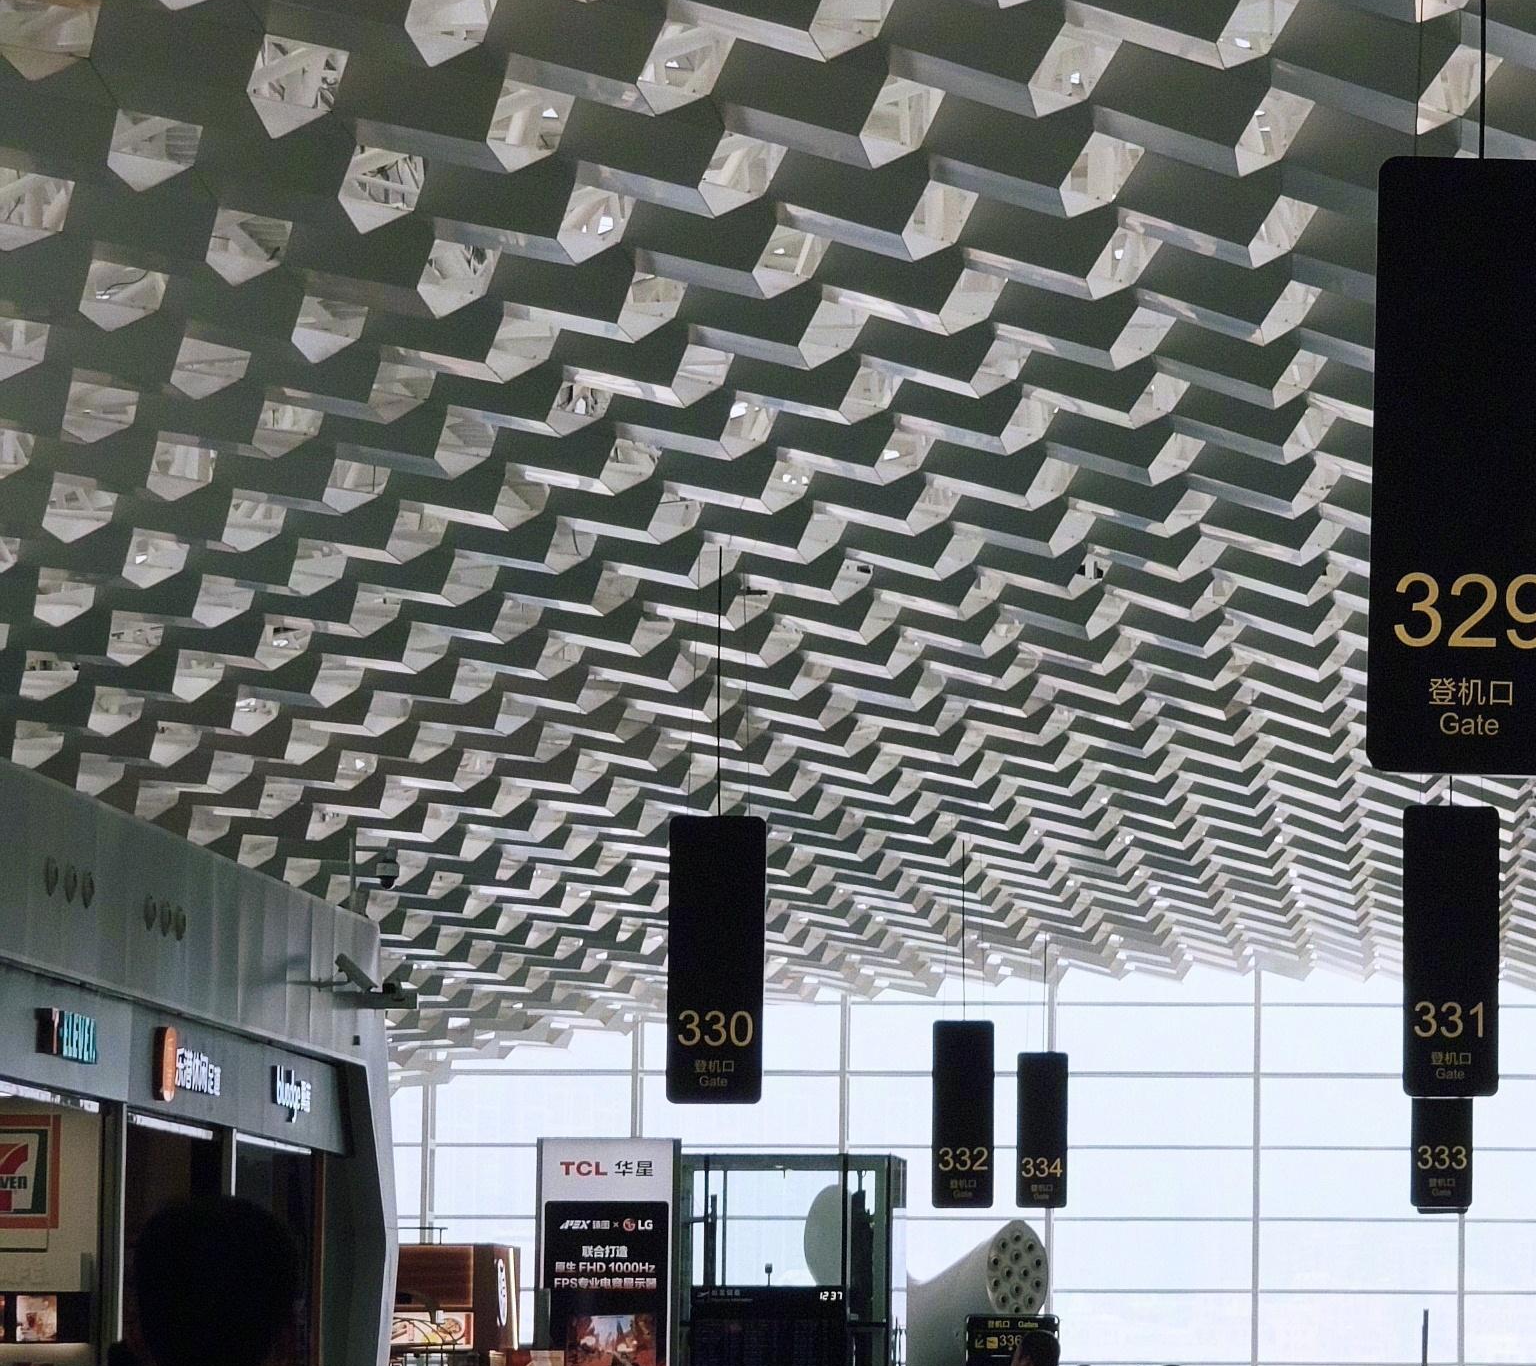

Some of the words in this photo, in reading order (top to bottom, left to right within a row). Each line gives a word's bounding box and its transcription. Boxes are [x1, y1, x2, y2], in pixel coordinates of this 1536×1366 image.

[1429, 677, 1513, 706] 登机口
[1439, 712, 1499, 735] Gate
[1414, 1001, 1484, 1038] 331
[678, 1010, 753, 1047] 330
[694, 1059, 734, 1073] 登机口
[1431, 1051, 1472, 1065] 登机口
[699, 1076, 728, 1087] Gate
[1436, 1068, 1465, 1079] Gate
[938, 1147, 988, 1171] 332
[1417, 1145, 1467, 1169] 333
[560, 1161, 608, 1176] TCL
[614, 1160, 653, 1176] 华星
[1021, 1157, 1063, 1177] 334
[638, 1220, 653, 1230] LG
[582, 1245, 628, 1258] 联合打造
[579, 1262, 606, 1273] FHD
[609, 1262, 656, 1273] 1000Hz
